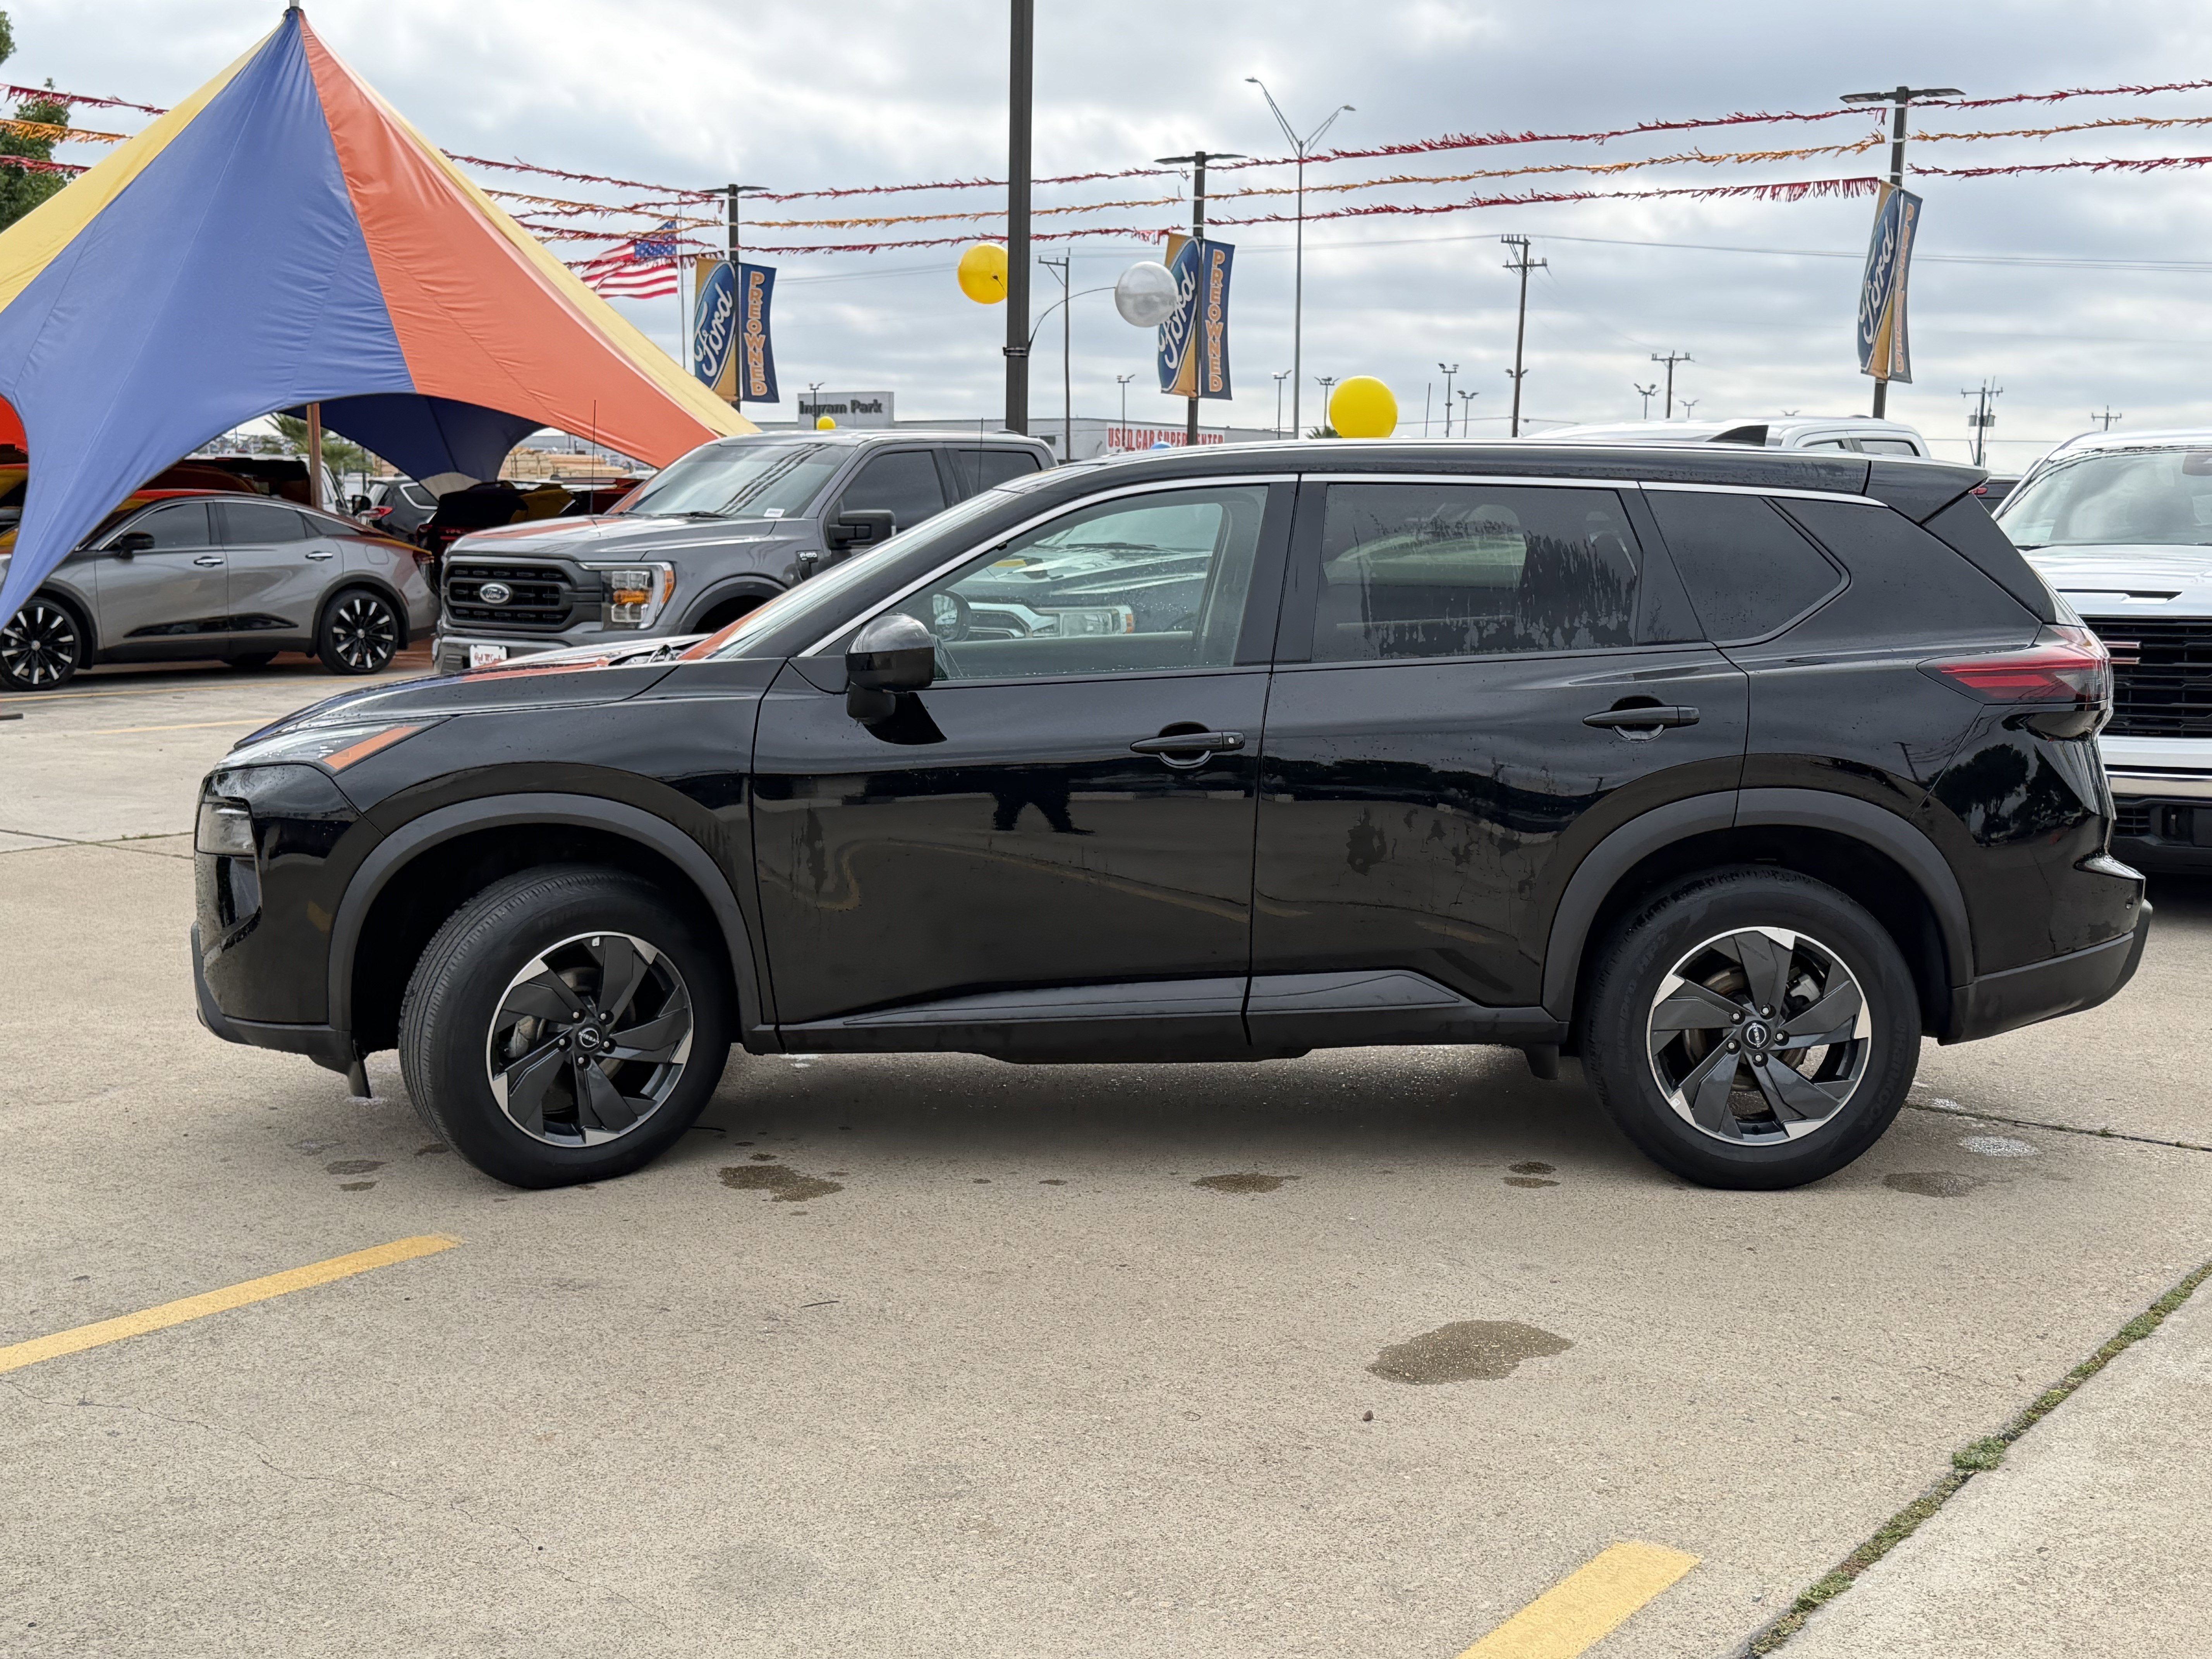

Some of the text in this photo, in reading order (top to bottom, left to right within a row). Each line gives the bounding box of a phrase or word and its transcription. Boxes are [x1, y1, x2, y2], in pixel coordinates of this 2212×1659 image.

[694, 282, 733, 377] Ford
[743, 271, 768, 396] PREOWNED
[1205, 249, 1225, 392] PREOWNED
[1858, 216, 1894, 344] Ford
[799, 399, 883, 418] Ingram Park
[1136, 429, 1154, 450] CAR
